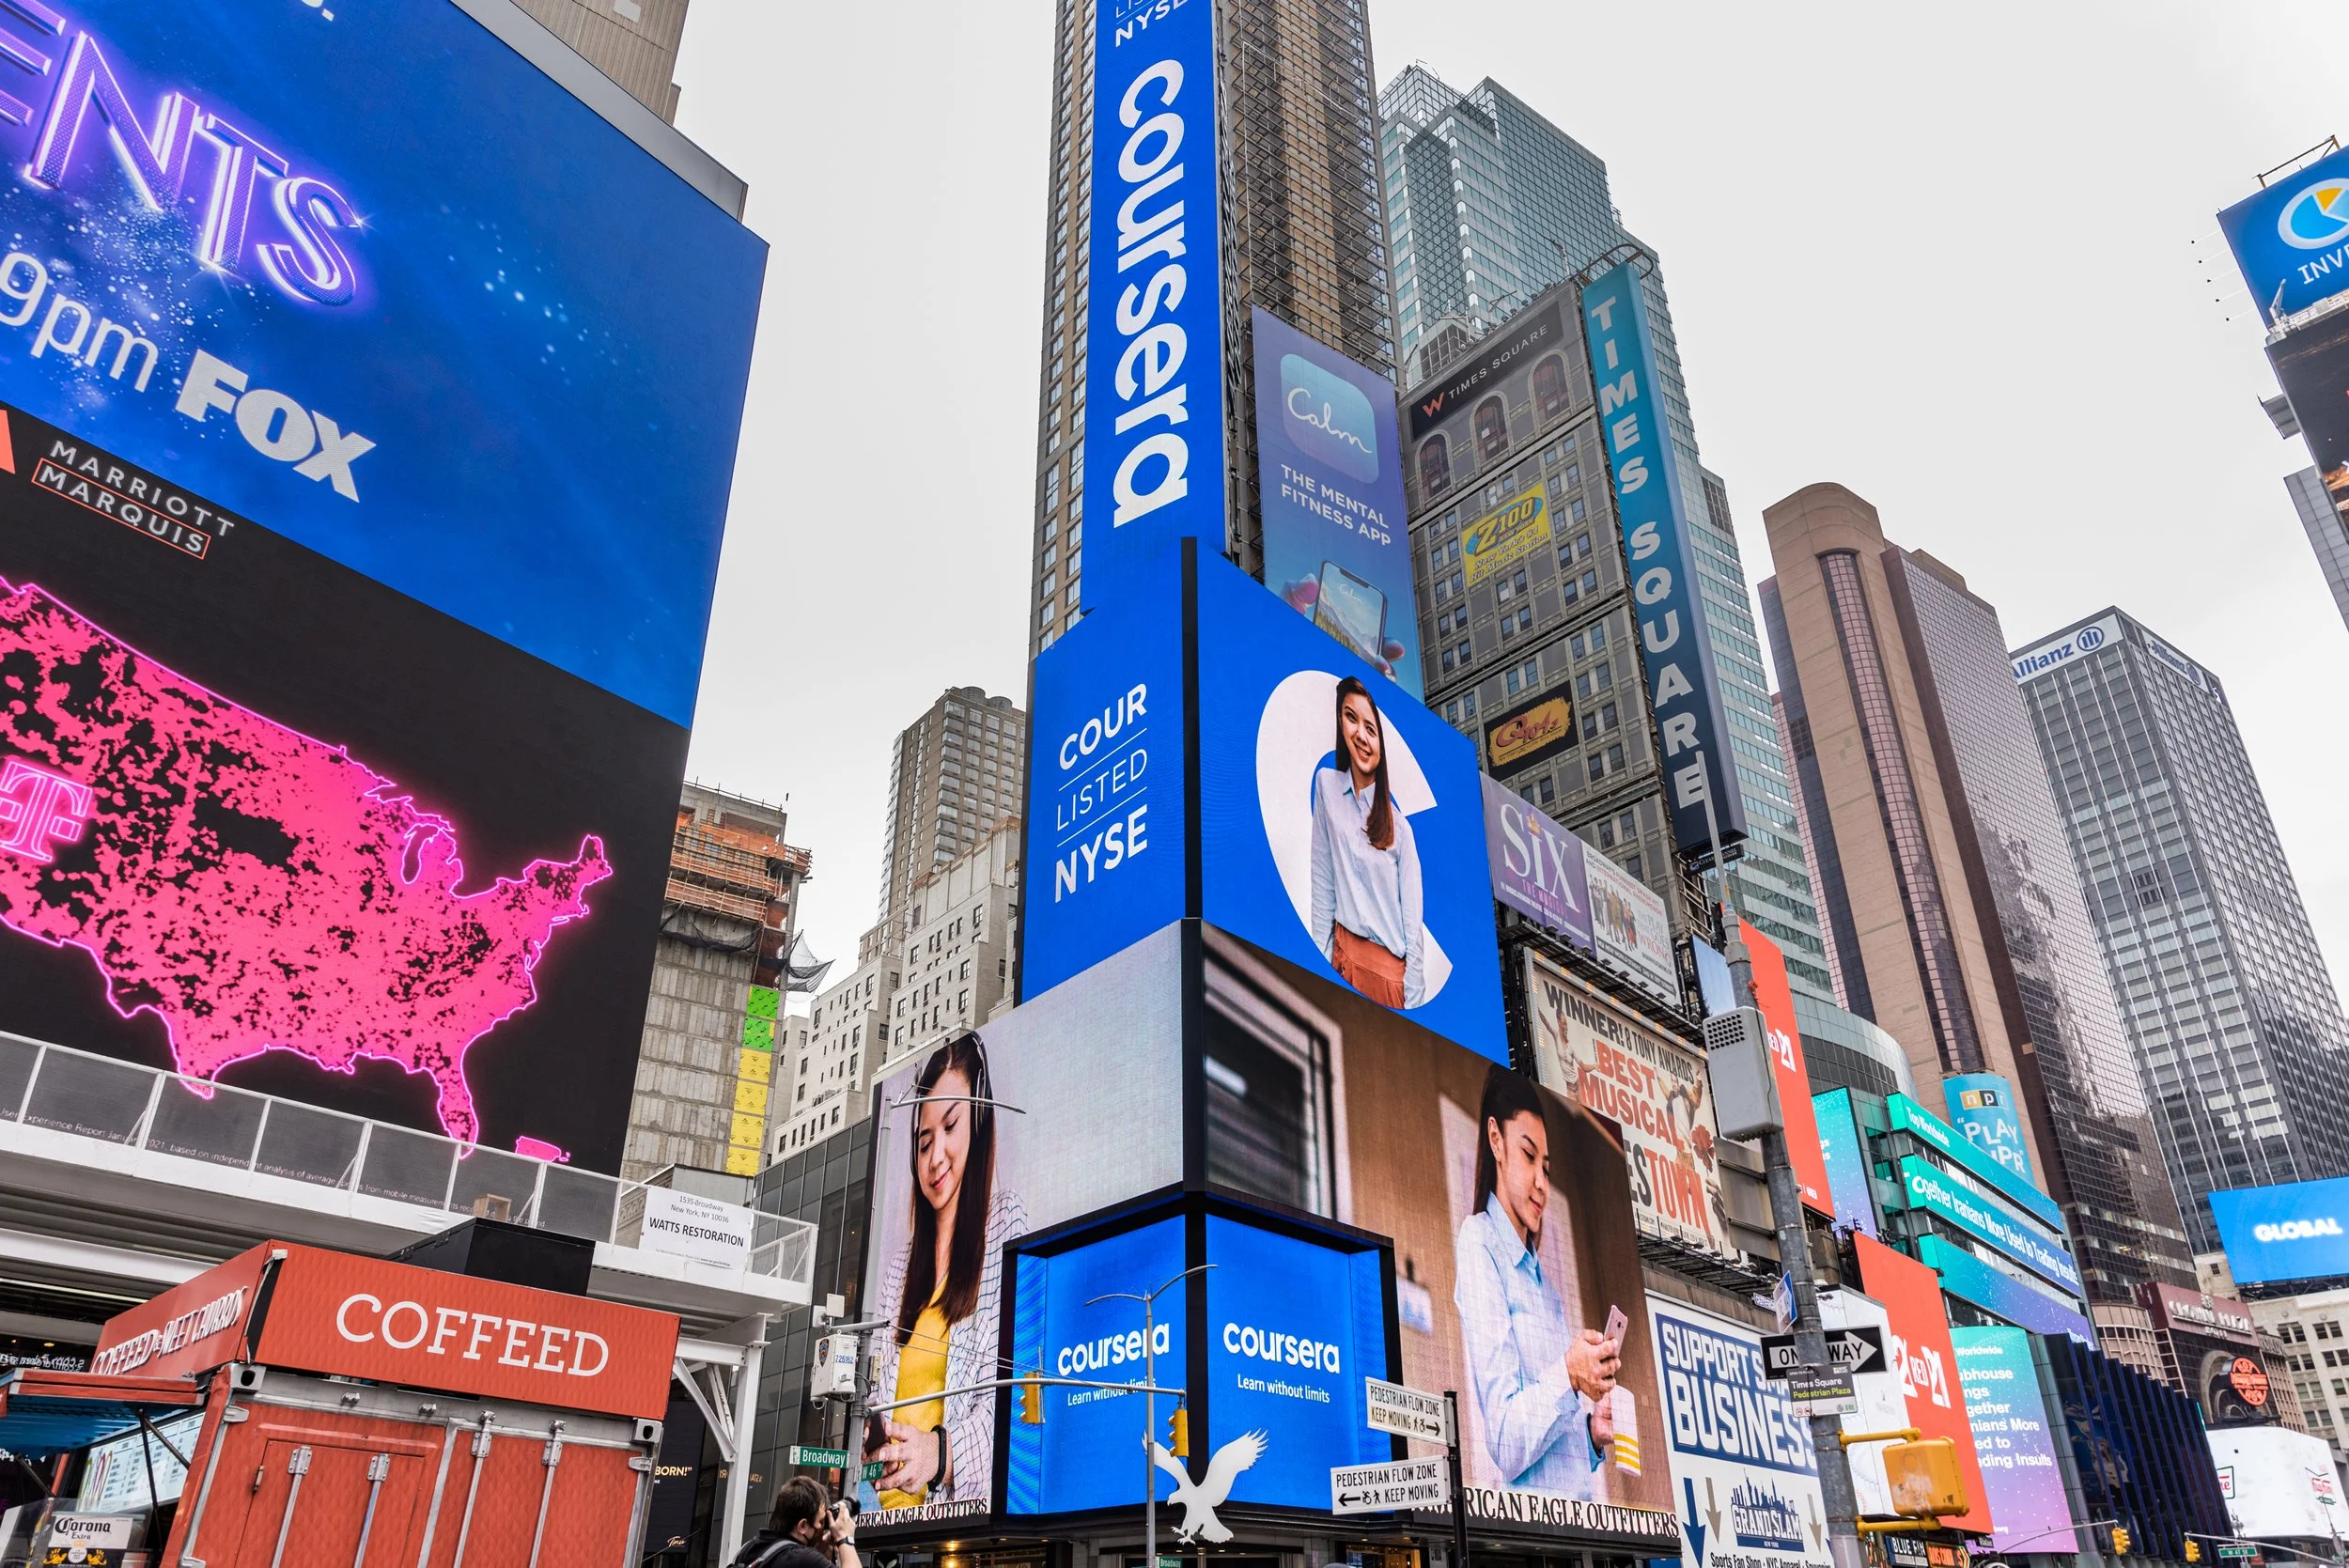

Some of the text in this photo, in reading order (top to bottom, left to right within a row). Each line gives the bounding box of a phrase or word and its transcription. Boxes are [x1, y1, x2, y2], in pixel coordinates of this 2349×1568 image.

[1112, 59, 1189, 529] coursera
[0, 250, 160, 393] 9pm
[1423, 324, 1548, 418] W TIMES SQUARE
[175, 349, 376, 504] FOX
[1287, 387, 1373, 454] Calm
[50, 438, 235, 538] MARRIOTT
[1281, 464, 1390, 529] THE MENTAL
[39, 464, 206, 553] MARQUIS
[1281, 484, 1392, 547] FITNESS APP
[1474, 496, 1536, 557] Z100
[1592, 295, 1706, 810] TIMES SQUARE
[1059, 683, 1147, 770] COUR
[1057, 749, 1148, 832] LISTED
[1055, 803, 1148, 904] NYSE
[1501, 803, 1580, 914] SIX
[1543, 980, 1626, 1047] WINNER!
[1625, 1026, 1632, 1051] 8
[1633, 1032, 1656, 1062] TONY
[1657, 1046, 1695, 1082] AWARDS
[1596, 1039, 1656, 1100] BEST
[1579, 1067, 1685, 1152] MUSICAL
[1965, 1093, 2004, 1106] npr
[75, 1122, 106, 1138] Report
[170, 1142, 197, 1157] based
[198, 1149, 210, 1159] on
[211, 1152, 263, 1172] independnt
[264, 1163, 296, 1178] analysis
[296, 1169, 305, 1178] of
[306, 1172, 337, 1187] average
[365, 1183, 382, 1195] from
[383, 1189, 408, 1201] mobile
[409, 1193, 459, 1212] measuremnts
[670, 1204, 685, 1214] New
[686, 1206, 700, 1218] York,
[711, 1213, 730, 1223] 10036
[679, 1195, 724, 1213] 1535 Broadway
[649, 1217, 744, 1248] WATTS RESTORATION
[1951, 1190, 1986, 1231] Iranians
[1983, 1210, 2007, 1243] More
[2004, 1223, 2026, 1254] Used
[2024, 1236, 2034, 1259] to
[2031, 1240, 2061, 1279] Trading
[2253, 1218, 2343, 1242] GLOBAL
[91, 1328, 160, 1375] COFFEED
[336, 1293, 610, 1377] COFFEED
[1222, 1322, 1341, 1375] coursera
[1661, 1321, 1751, 1387] SUPPORT
[1955, 1345, 2004, 1357] Worldwide
[1779, 1343, 1863, 1366] ON WAY
[1908, 1356, 1930, 1388] RED
[1067, 1391, 1092, 1406] Learn
[1129, 1376, 1157, 1393] limis
[1237, 1374, 1330, 1405] Learn without limits
[1370, 1385, 1440, 1417] PEDESTRIAN FLOW ZONE
[1791, 1378, 1843, 1389] Times Square
[1793, 1387, 1852, 1399] Pedestrian Plaza
[1372, 1406, 1411, 1429] KEEP MOVING
[1667, 1369, 1818, 1470] BUSINESS
[2011, 1418, 2040, 1433] More
[802, 1449, 847, 1467] Broadway
[1996, 1436, 2011, 1450] to
[2016, 1452, 2053, 1467] Insults
[869, 1465, 877, 1478] 46
[1336, 1464, 1438, 1488] PEDESTRIAN FLOW ZONE
[894, 1505, 925, 1524] EAGLE
[926, 1498, 988, 1521] OUTFITTERS
[1384, 1483, 1439, 1503] KEEP MOVING
[54, 1517, 112, 1536] Corona
[1527, 1494, 1583, 1527] EAGLE
[1587, 1502, 1680, 1538] OUTFITTERS
[71, 1532, 91, 1541] Extra
[1891, 1537, 1913, 1555] BLUE
[1710, 1551, 1733, 1568] Sports
[1733, 1554, 1745, 1568] Fan
[1746, 1555, 1762, 1568] Shop
[1766, 1557, 1779, 1568] NYC
